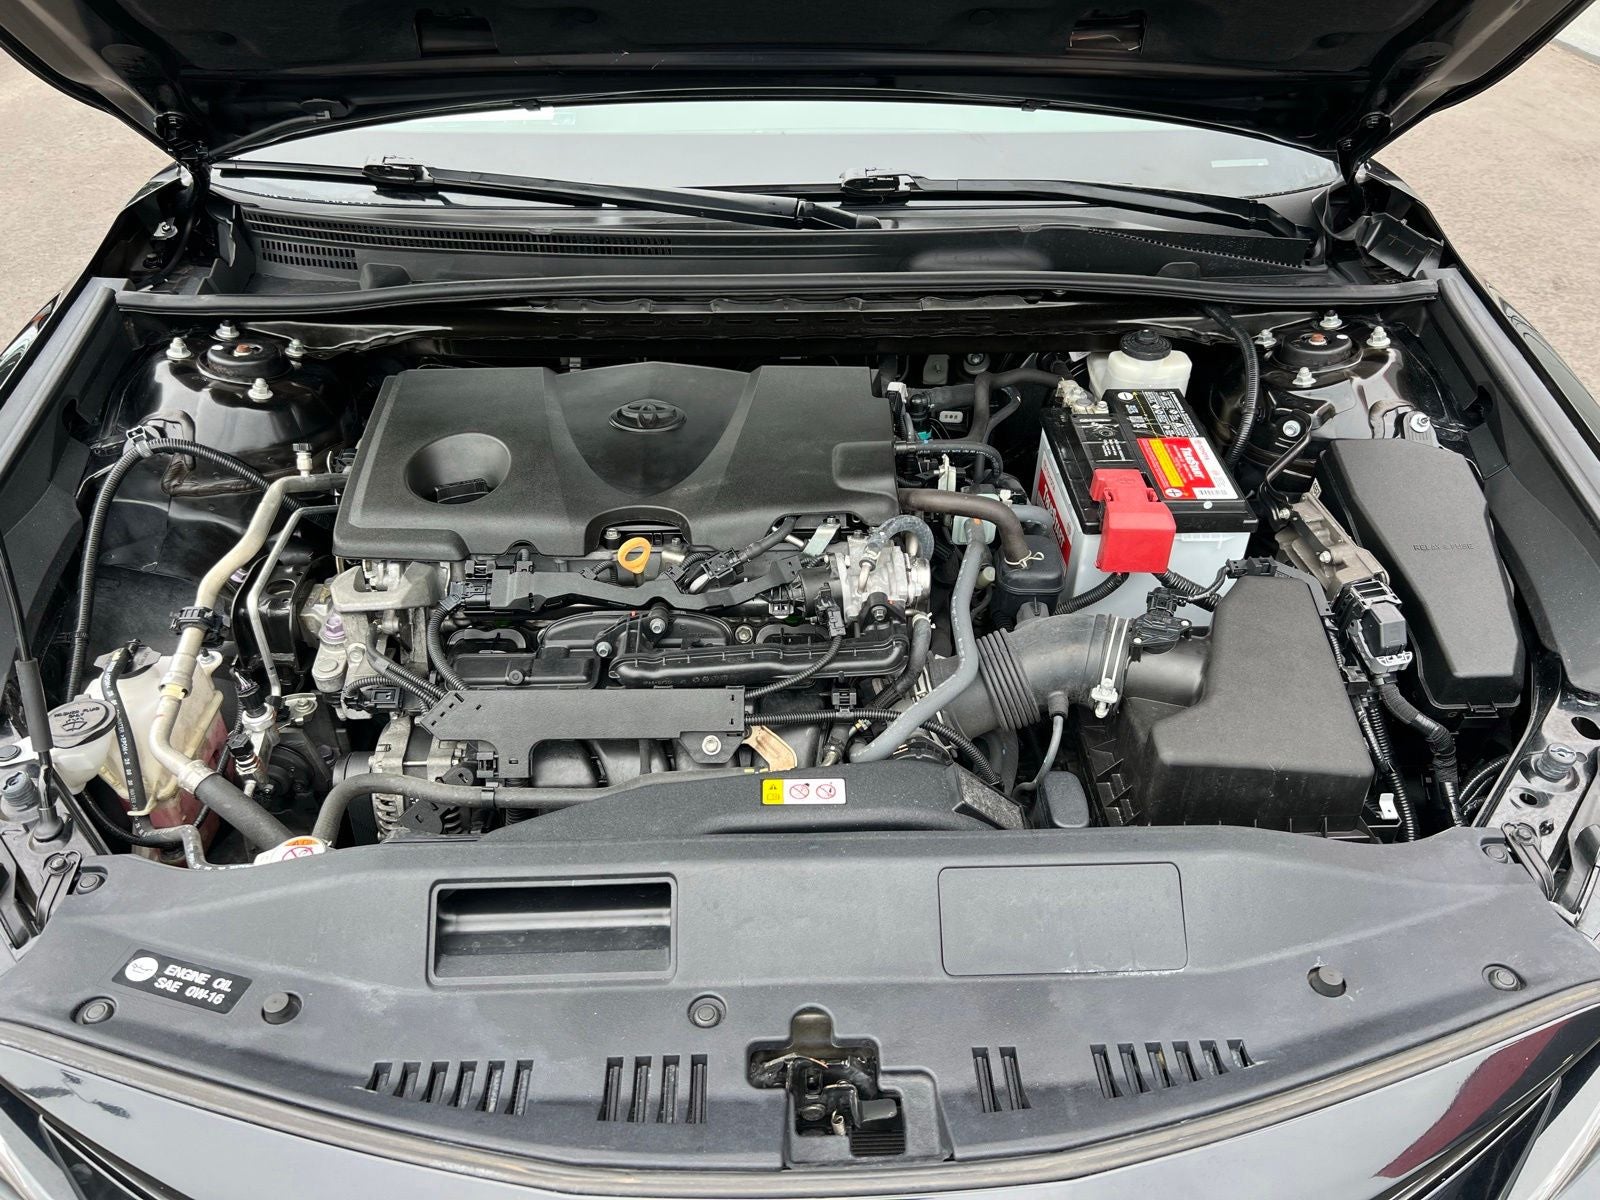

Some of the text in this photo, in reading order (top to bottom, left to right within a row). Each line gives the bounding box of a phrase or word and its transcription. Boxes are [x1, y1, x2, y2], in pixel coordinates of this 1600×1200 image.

[153, 977, 225, 1005] SAE 0W-16
[163, 964, 233, 992] ENGINE OIL
